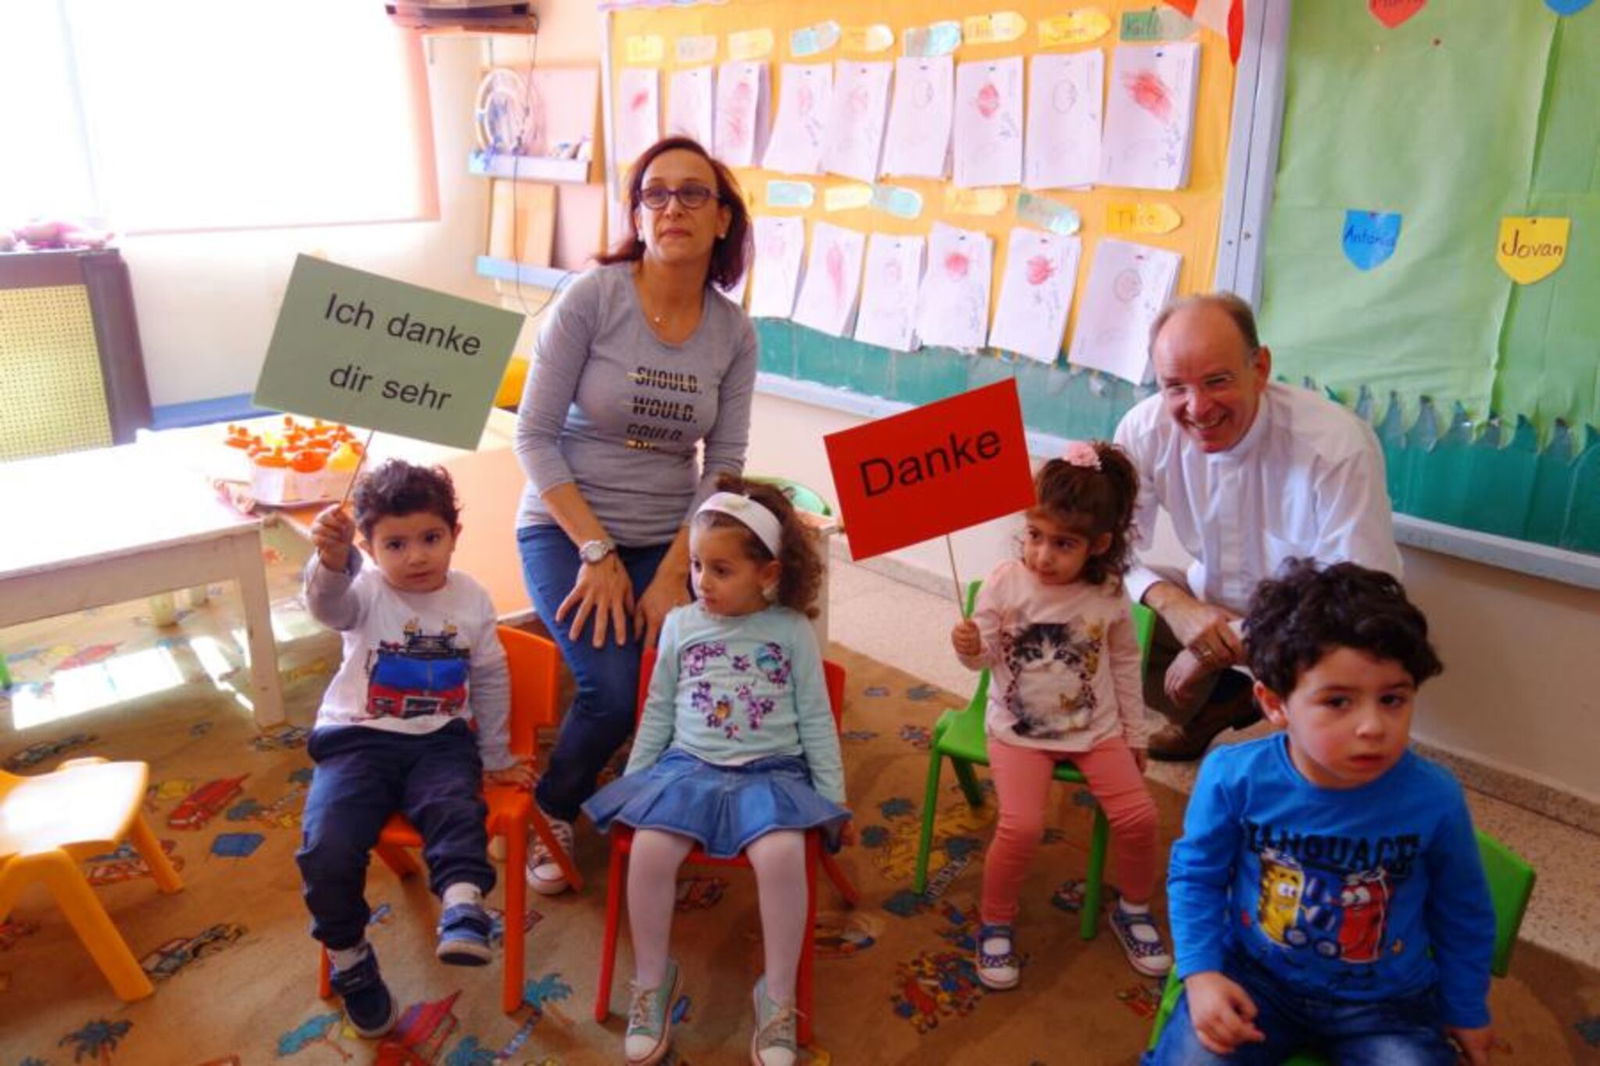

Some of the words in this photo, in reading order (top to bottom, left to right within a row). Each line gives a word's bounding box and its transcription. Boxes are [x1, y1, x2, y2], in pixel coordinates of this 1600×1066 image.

[1502, 229, 1564, 259] Jovan
[324, 292, 374, 330] Ich
[386, 311, 482, 356] danke
[329, 363, 373, 393] dir
[381, 378, 452, 412] sehr
[859, 430, 1002, 498] Danke
